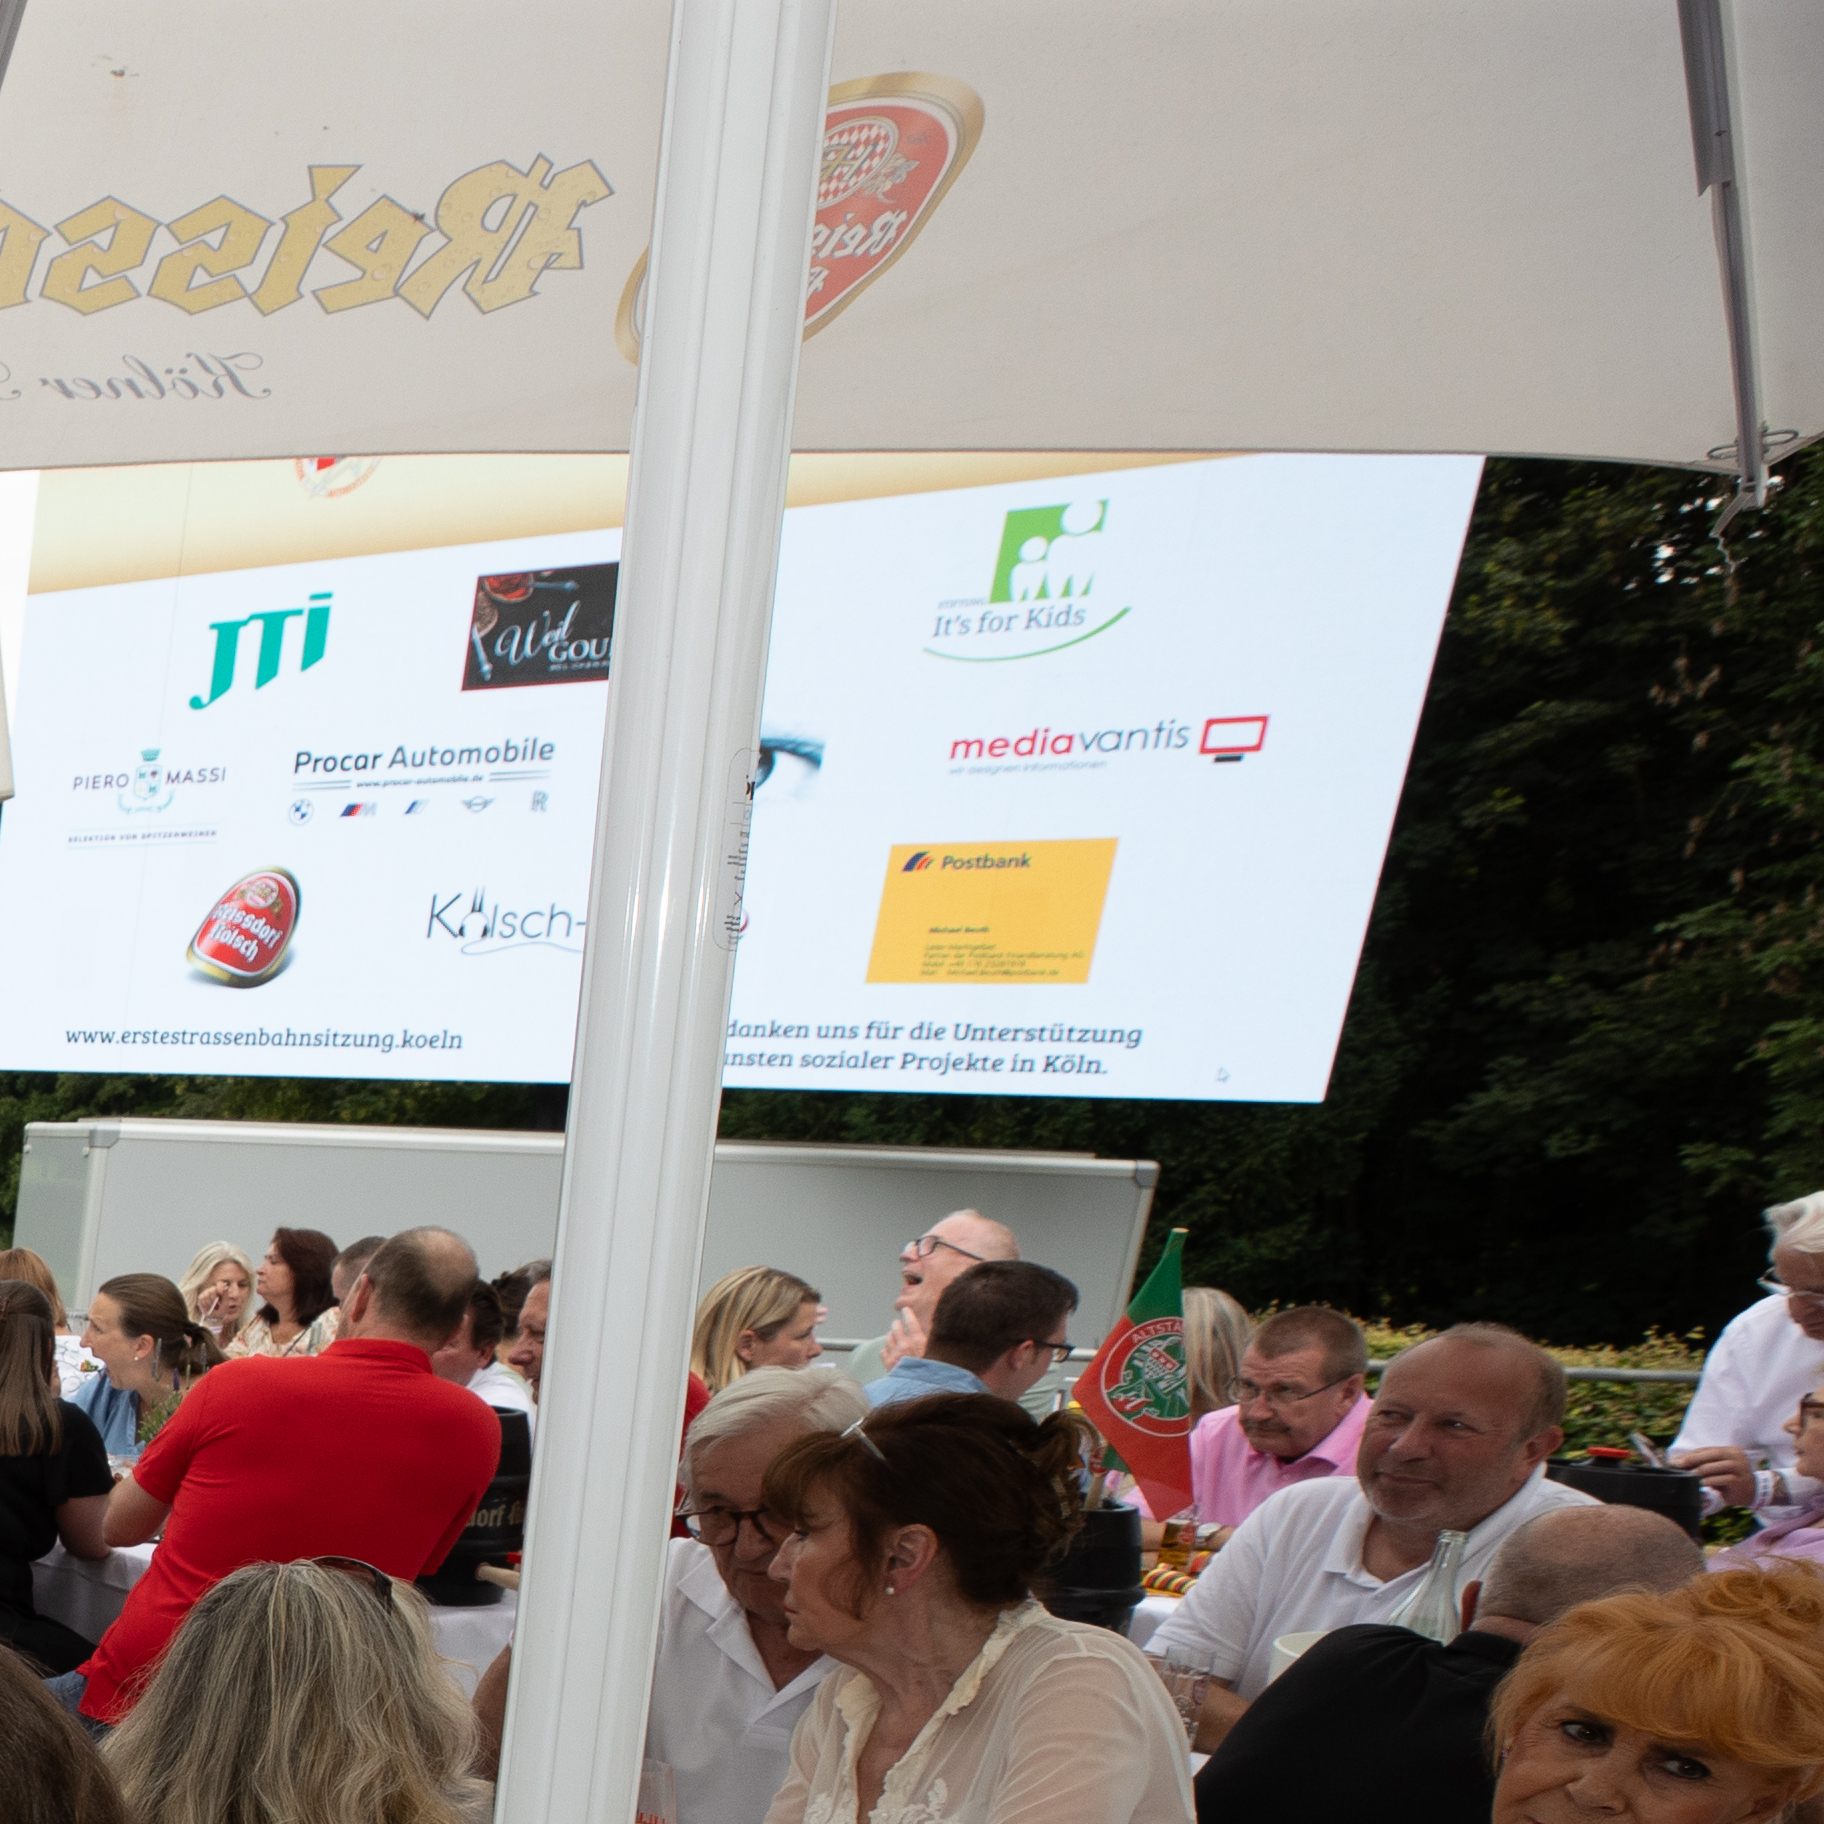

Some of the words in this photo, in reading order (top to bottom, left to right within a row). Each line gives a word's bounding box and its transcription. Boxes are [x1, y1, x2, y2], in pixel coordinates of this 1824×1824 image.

[977, 610, 1020, 635] for
[1024, 603, 1087, 631] Kids
[950, 718, 1192, 760] mediavantis
[294, 750, 383, 775] Procar
[388, 737, 556, 770] Automobile
[72, 773, 130, 791] PIERO
[165, 766, 227, 785] MASSI
[941, 852, 1032, 871] Postbank
[65, 1026, 464, 1053] www.erstestrassenbahnsitzung.koeln
[727, 1020, 810, 1040] danken
[817, 1024, 860, 1040] uns
[864, 1020, 905, 1041] für
[910, 1022, 947, 1041] die
[953, 1022, 1143, 1049] Unterstützung
[799, 1052, 894, 1070] sozialer
[900, 1052, 1003, 1076] Projekte
[1010, 1054, 1035, 1073] in
[1043, 1054, 1109, 1075] Köln.
